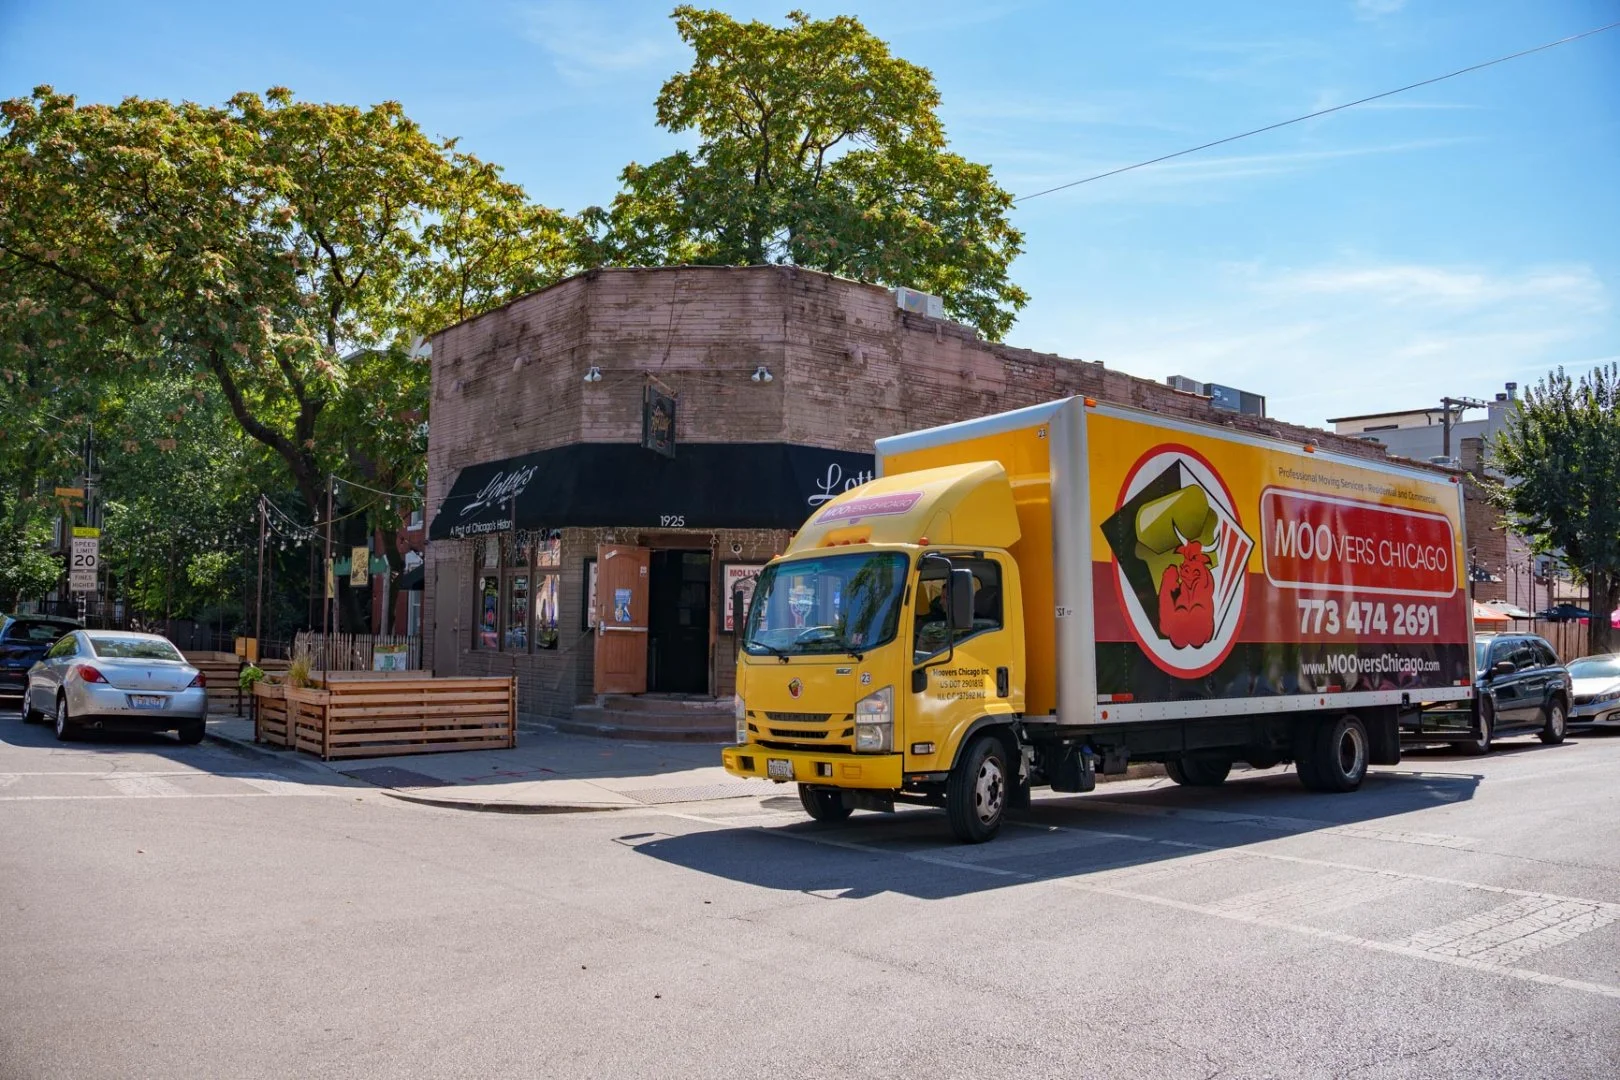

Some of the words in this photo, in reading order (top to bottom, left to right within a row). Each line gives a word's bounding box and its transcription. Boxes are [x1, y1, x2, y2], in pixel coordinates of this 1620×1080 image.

[808, 463, 874, 506] Lott
[1278, 466, 1317, 483] Professional
[1318, 474, 1340, 489] Moving
[1341, 479, 1364, 492] Services
[1398, 489, 1408, 500] and
[449, 525, 455, 536] A
[466, 523, 472, 534] of
[472, 521, 496, 533] Chicago's
[497, 518, 513, 531] History
[660, 515, 685, 527] 1925
[74, 555, 95, 567] 20
[1379, 542, 1448, 572] CHICAGO
[1298, 599, 1339, 636] 773
[1346, 601, 1388, 635] 474
[1393, 604, 1439, 636] 2691
[958, 667, 980, 677] Chicago
[981, 667, 989, 675] Inc
[1302, 654, 1440, 676] www.MOOversChicago.com
[861, 673, 871, 683] 23
[940, 680, 948, 688] US
[949, 680, 960, 688] DOT
